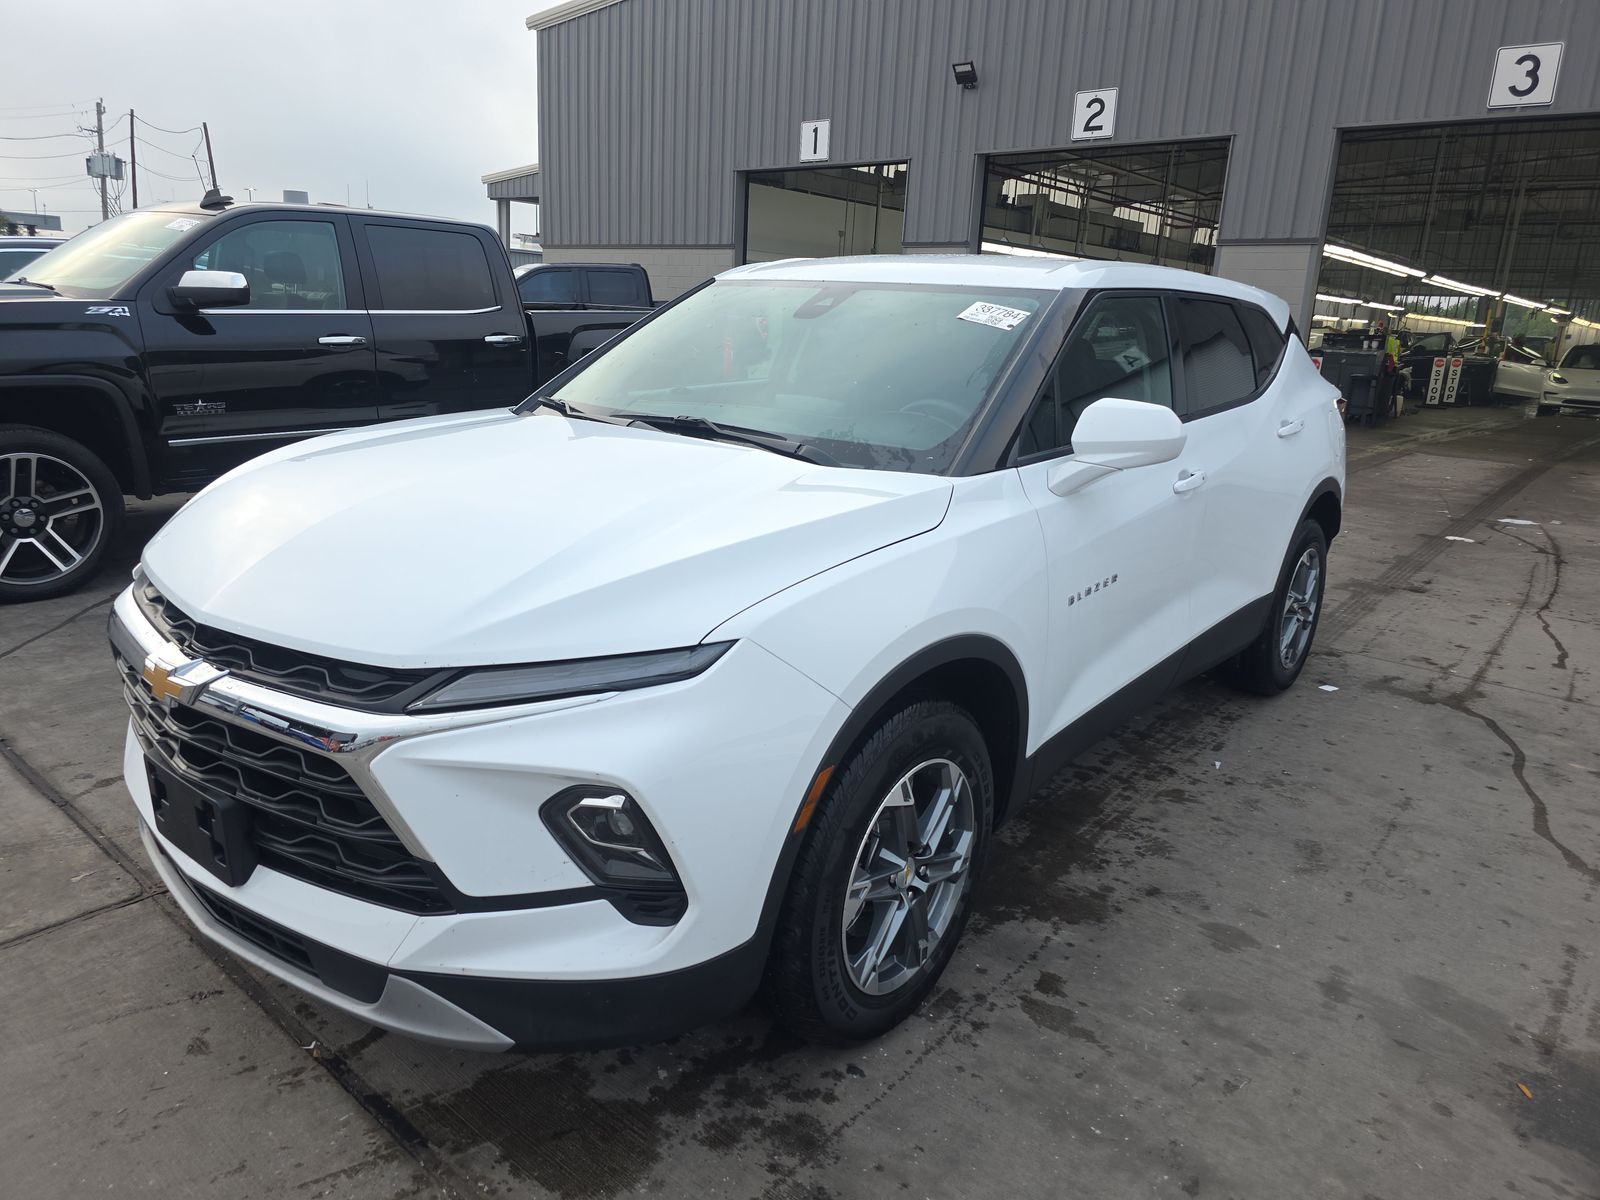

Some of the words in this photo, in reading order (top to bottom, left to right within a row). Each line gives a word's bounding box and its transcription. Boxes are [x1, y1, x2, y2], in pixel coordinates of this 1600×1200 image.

[1508, 54, 1541, 97] 3
[1083, 97, 1105, 132] 2
[812, 126, 818, 155] 1
[1430, 369, 1441, 403] STOP
[1446, 369, 1458, 401] STOP
[1067, 573, 1119, 607] BLAZER
